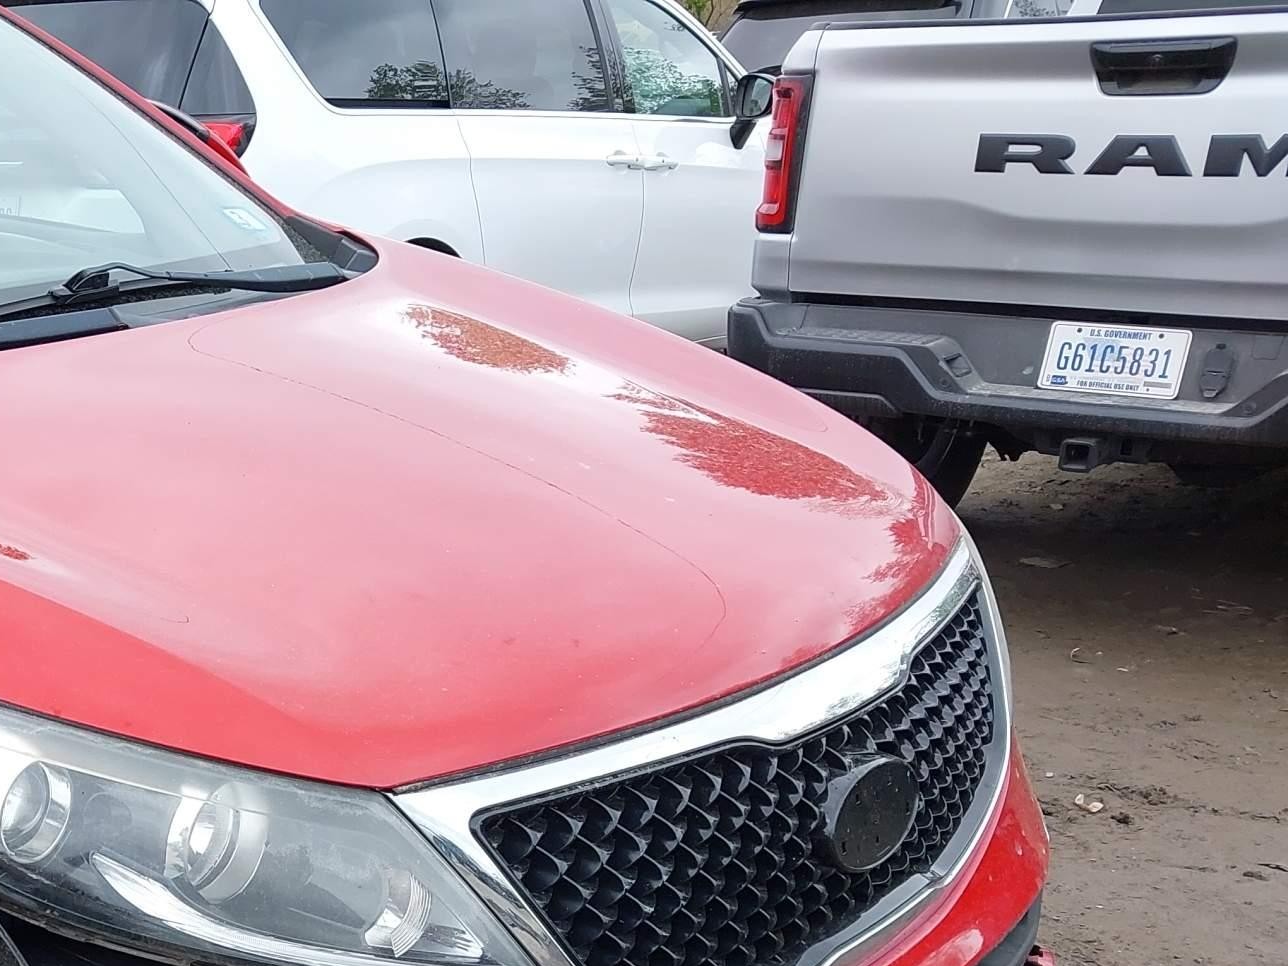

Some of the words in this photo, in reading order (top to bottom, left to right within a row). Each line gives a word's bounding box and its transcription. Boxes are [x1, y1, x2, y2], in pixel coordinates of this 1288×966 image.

[974, 133, 1288, 177] RAM
[1089, 328, 1102, 338] U.S.
[1103, 329, 1153, 341] GOVERNMENT
[1056, 341, 1172, 379] G61C5831
[1076, 379, 1088, 387] FOR
[1087, 380, 1113, 389] OFFICIAL
[1125, 384, 1140, 392] ONLY
